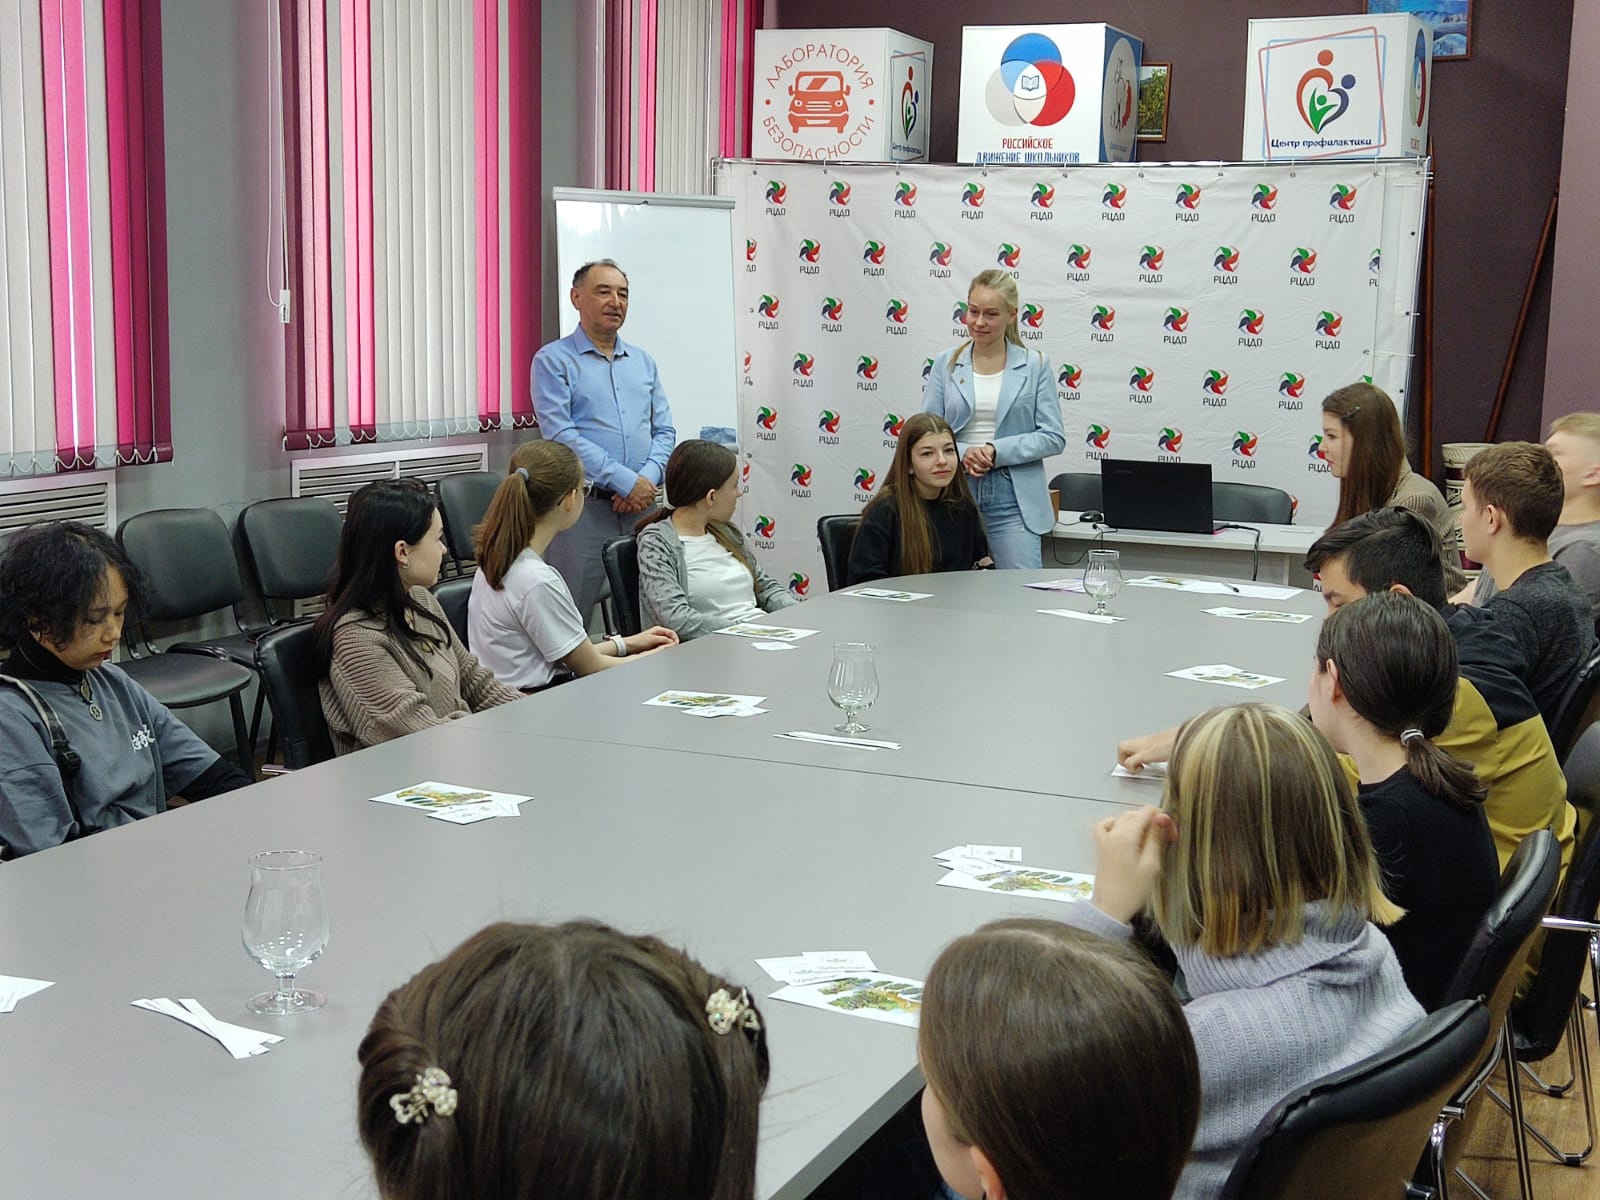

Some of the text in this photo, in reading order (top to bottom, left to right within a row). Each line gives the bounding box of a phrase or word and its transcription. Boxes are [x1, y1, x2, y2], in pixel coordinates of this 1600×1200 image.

[766, 43, 874, 89] ЛАБОРАТОРИЯ
[763, 115, 875, 160] БЕЗОПАСНОСТИ
[1002, 136, 1053, 149] РОССИЙСКОЕ
[1271, 137, 1372, 148] Центр профилактики
[976, 151, 1080, 163] ДВИЖЕНИЕ ШКОЛЬНИКОВ
[766, 208, 786, 216] РЦДО
[829, 209, 850, 217] РЦДО
[895, 209, 915, 218] РЦДО
[961, 211, 983, 220] РЦДО
[1030, 212, 1053, 221] РЦДО
[1102, 212, 1125, 222] РЦДО
[1175, 213, 1199, 222] РЦДО
[1251, 213, 1276, 223] РЦДО
[1329, 214, 1354, 224] РЦДО
[800, 266, 819, 274] РЦДО
[864, 268, 884, 276] РЦДО
[929, 270, 951, 278] РЦДО
[1067, 273, 1089, 281] РЦДО
[1139, 274, 1162, 283] РЦДО
[1213, 276, 1238, 284] РЦДО
[1290, 277, 1315, 286] РЦДО
[758, 321, 778, 330] РЦДО
[821, 324, 842, 332] РЦДО
[886, 326, 907, 335] РЦДО
[953, 328, 969, 337] РЦД
[1021, 330, 1043, 340] РЦДО
[1091, 333, 1114, 342] РЦДО
[1164, 335, 1187, 345] РЦДО
[1238, 338, 1262, 347] РЦДО
[1316, 340, 1340, 350] РЦДО
[793, 379, 813, 387] РЦДО
[857, 382, 877, 391] РЦДО
[1058, 391, 1081, 401] РЦДО
[1129, 395, 1152, 404] РЦДО
[1203, 398, 1226, 407] РЦДО
[1279, 401, 1303, 410] РЦДО
[756, 432, 776, 441] РЦДО
[819, 436, 839, 445] РЦДО
[1232, 459, 1256, 469] РЦДО
[791, 489, 811, 498] РЦДО
[755, 540, 774, 549] РЦДО
